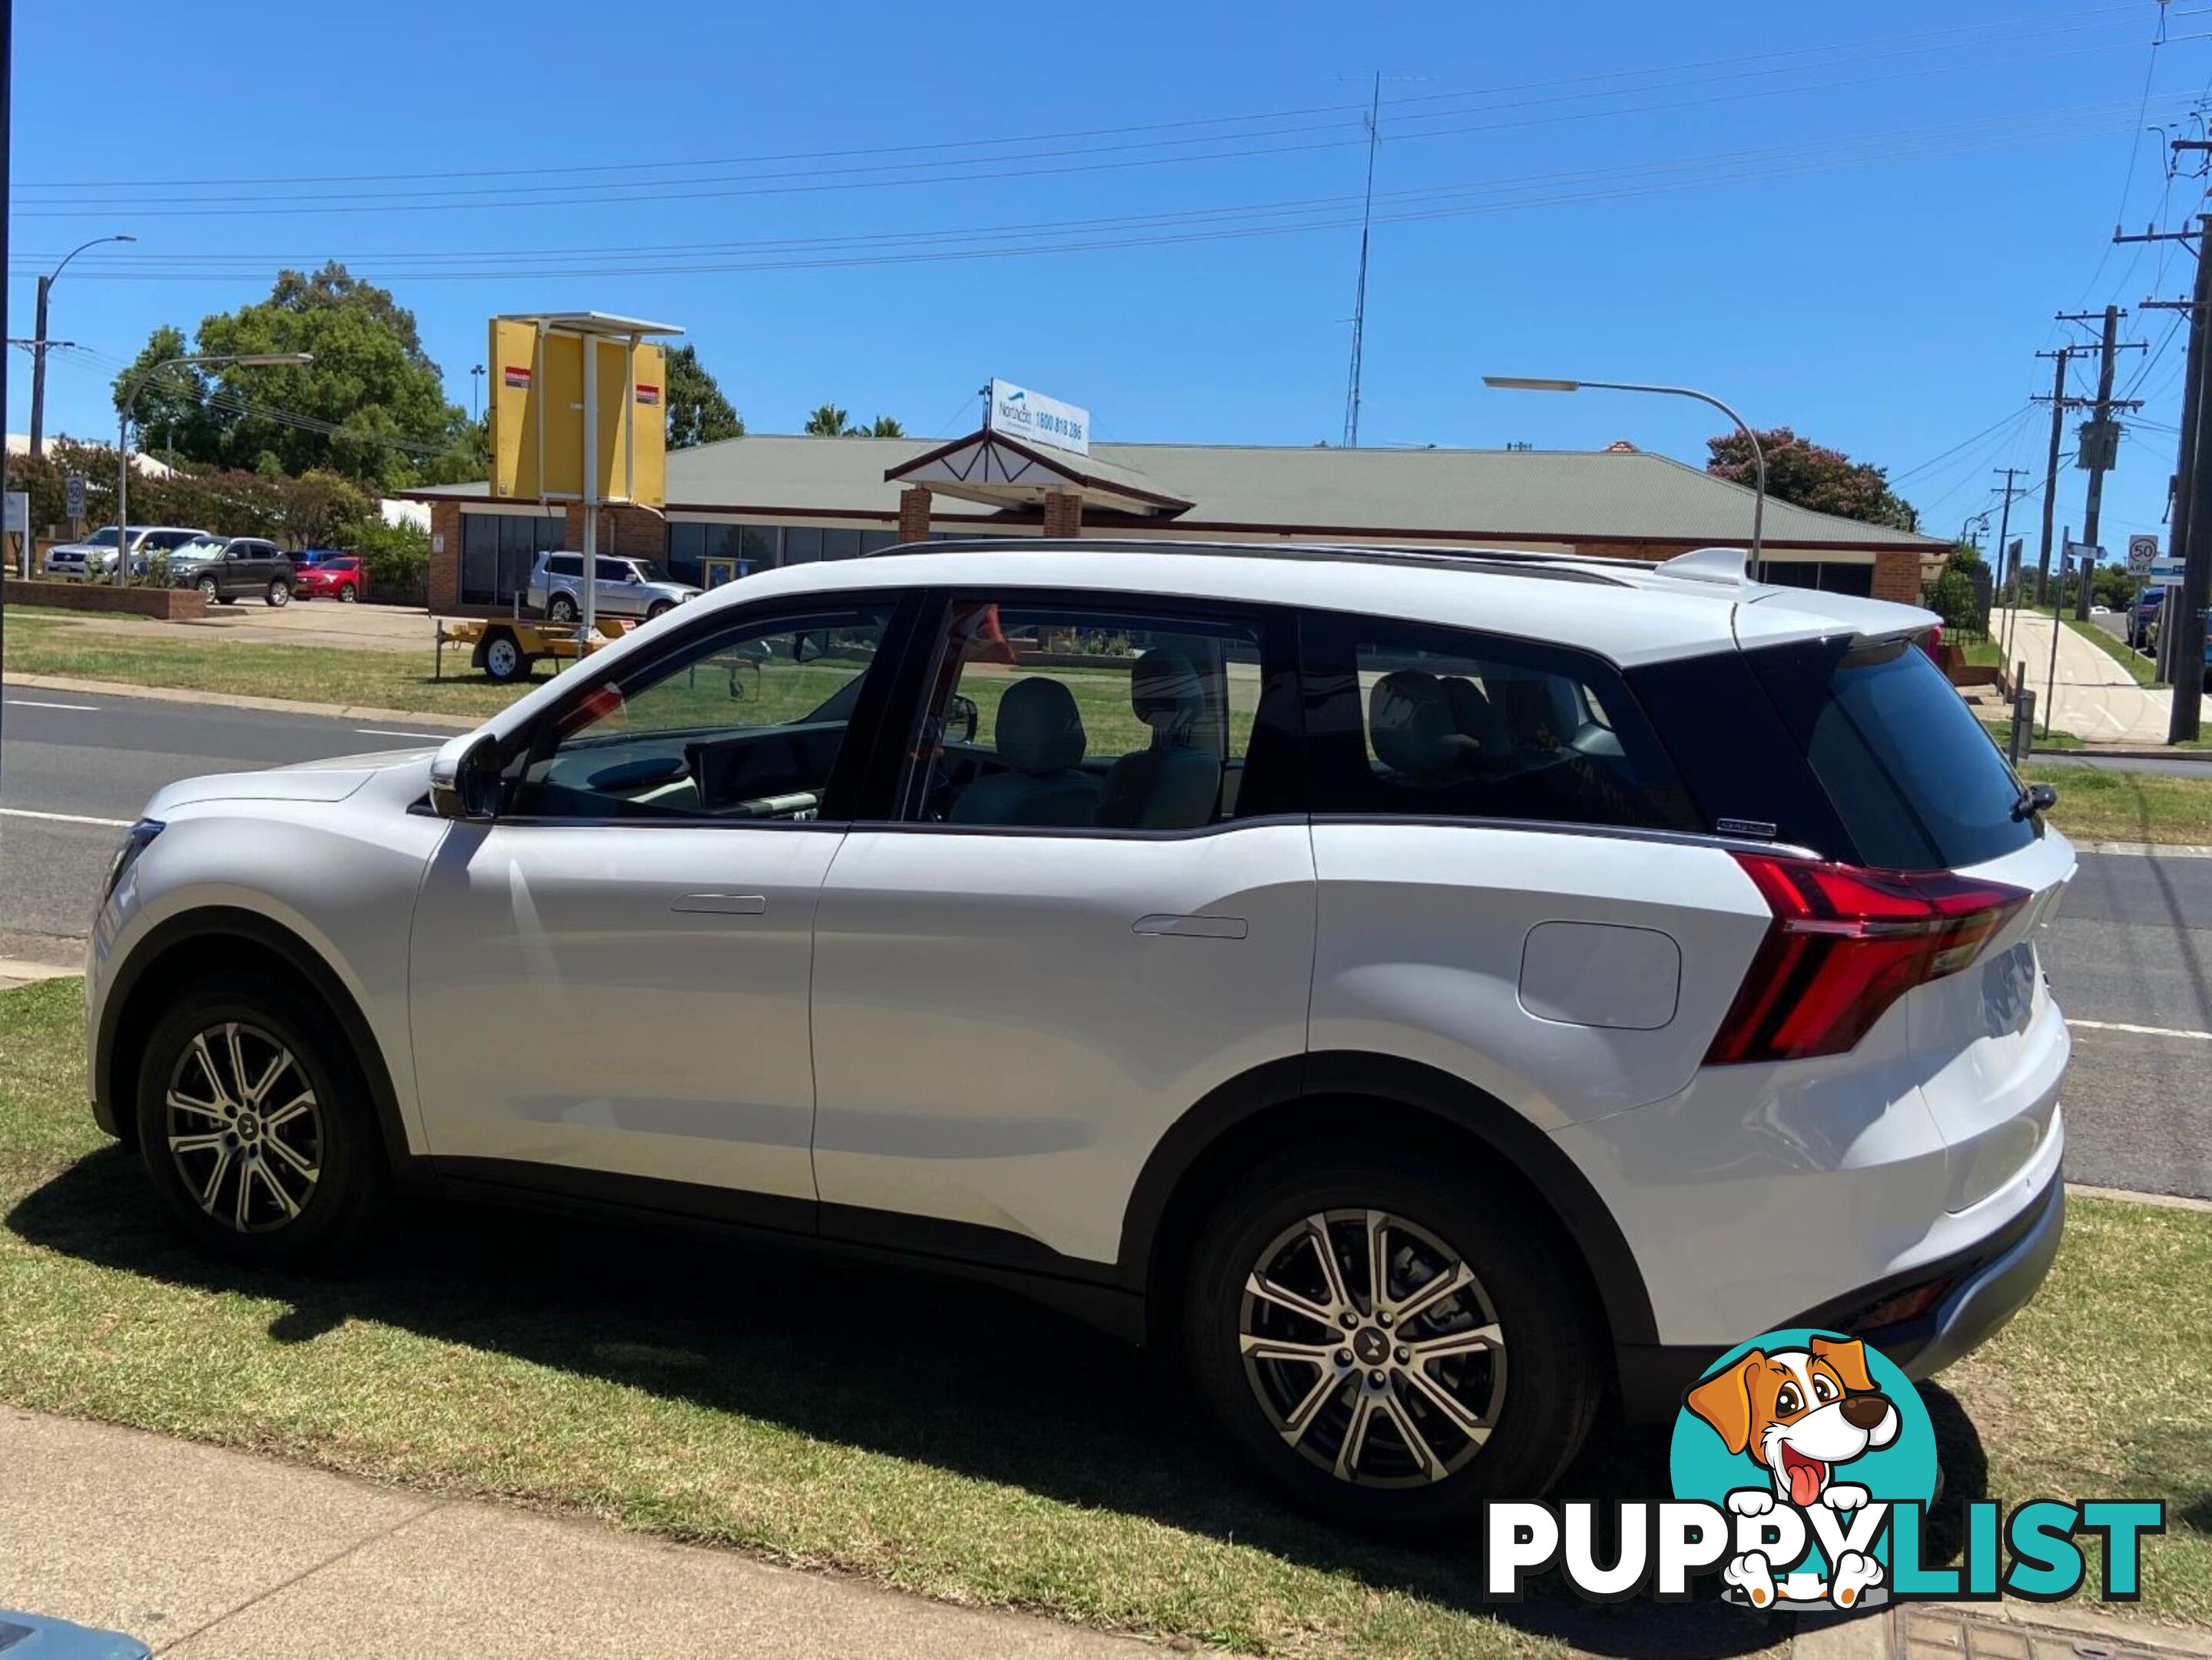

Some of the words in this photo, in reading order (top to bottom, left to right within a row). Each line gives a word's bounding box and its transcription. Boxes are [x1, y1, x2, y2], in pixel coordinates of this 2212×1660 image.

[1036, 411, 1053, 431] 1800
[1055, 417, 1068, 436] 818
[2134, 544, 2153, 557] 50
